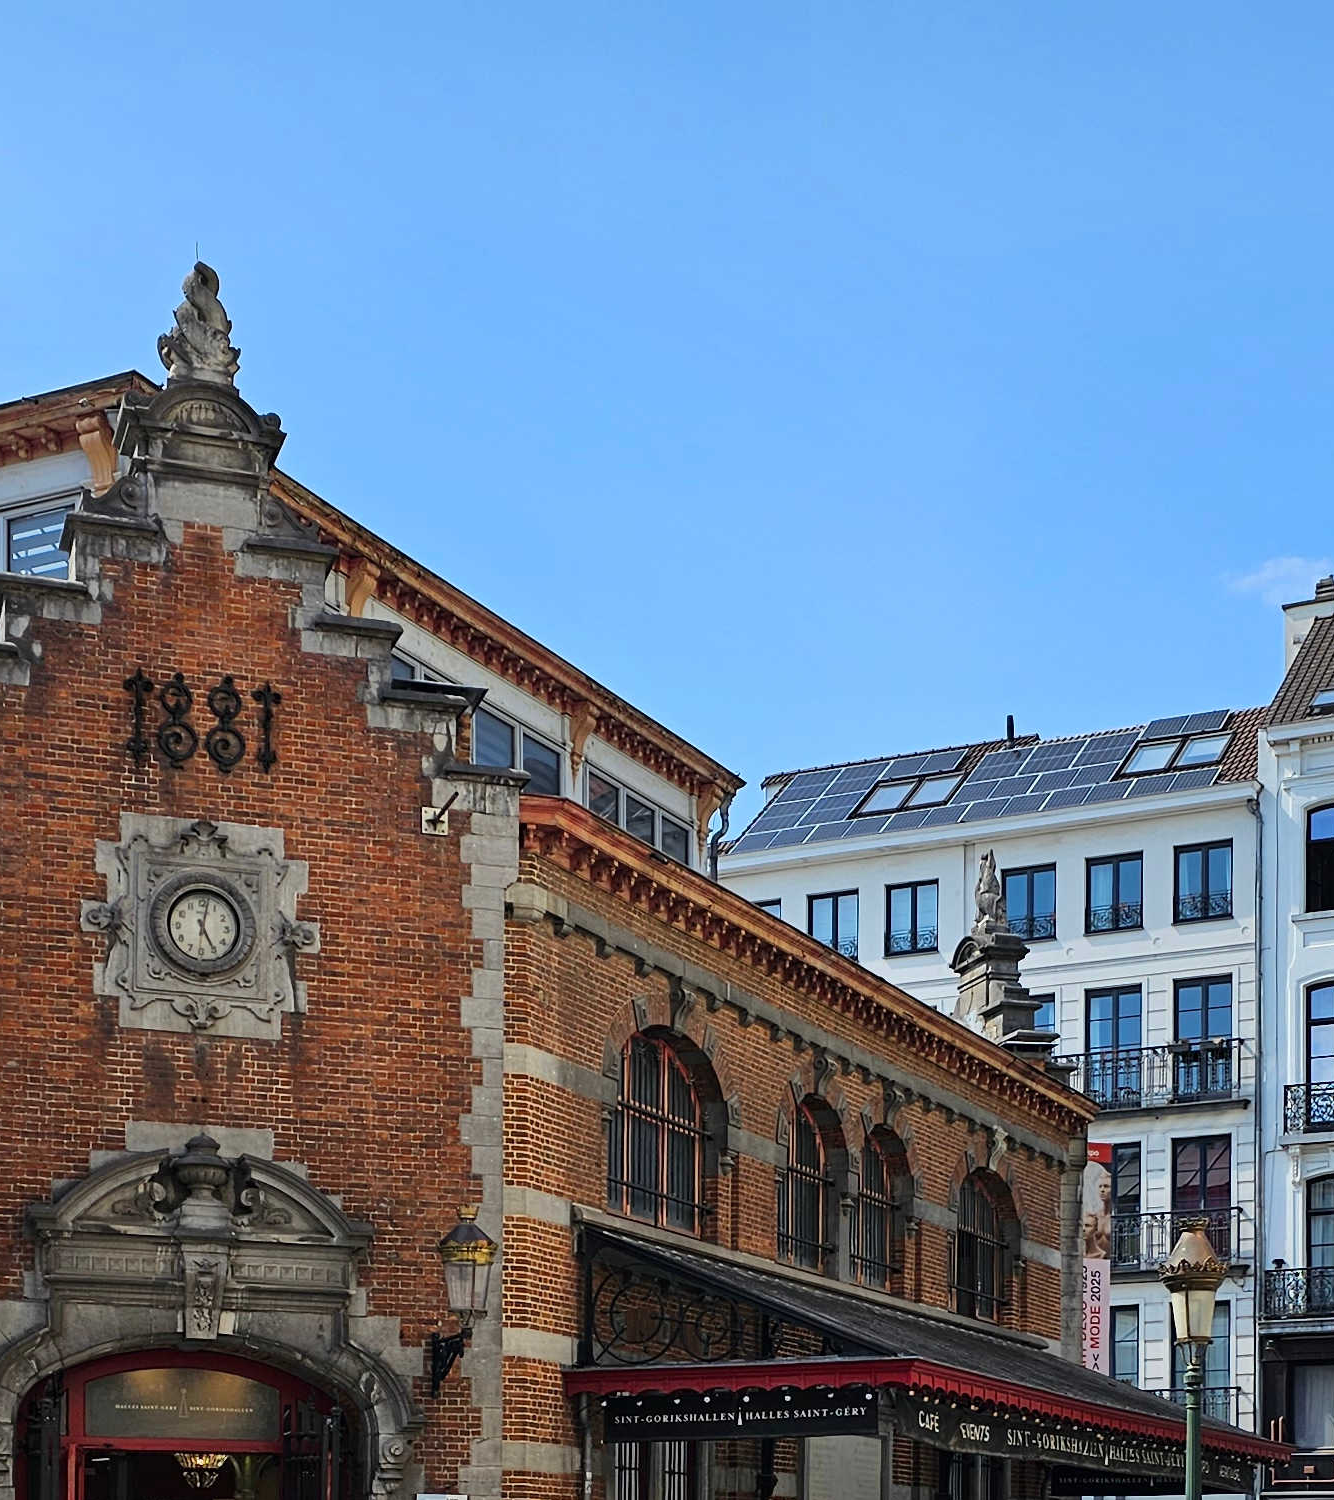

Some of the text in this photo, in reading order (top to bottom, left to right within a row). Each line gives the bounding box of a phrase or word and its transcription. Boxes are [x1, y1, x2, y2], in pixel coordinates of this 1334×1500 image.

[123, 667, 282, 774] 1881
[1090, 1270, 1102, 1302] 2025
[1090, 1305, 1101, 1349] MODE
[614, 1405, 868, 1425] SINT-GORIKSHALLEN HALLES SAINT-GÉRY
[918, 1409, 940, 1434] CAFÉ
